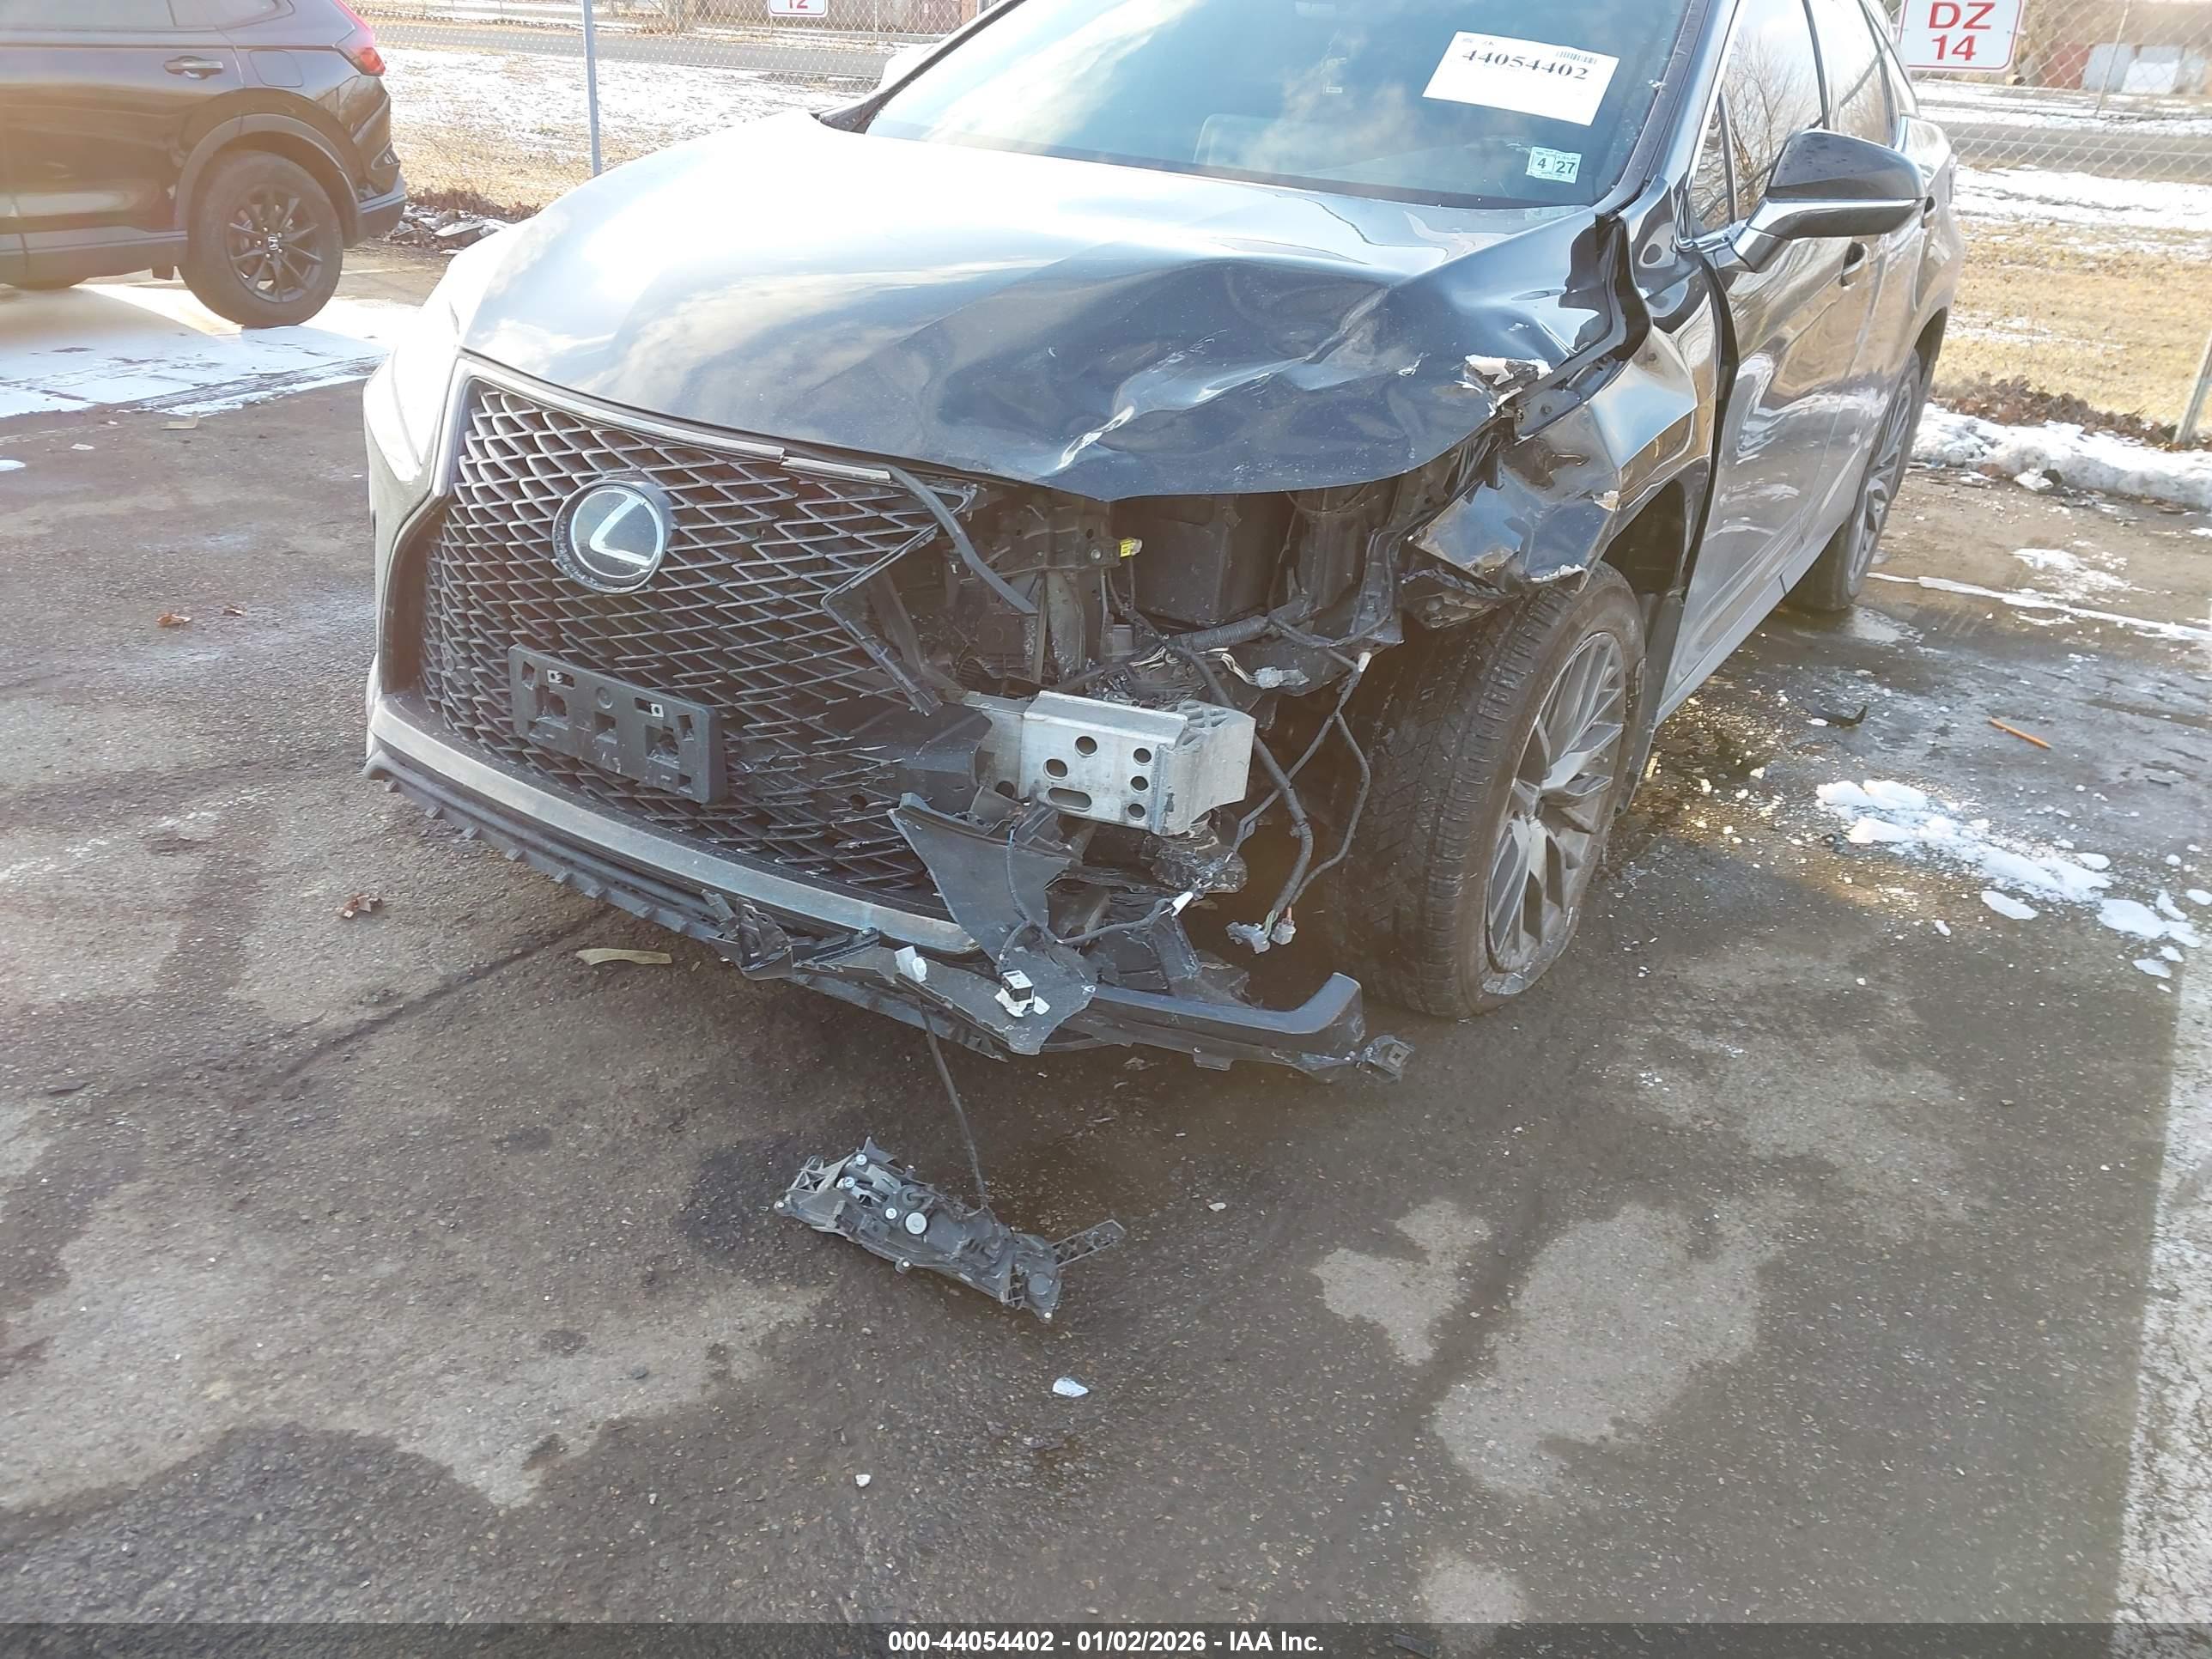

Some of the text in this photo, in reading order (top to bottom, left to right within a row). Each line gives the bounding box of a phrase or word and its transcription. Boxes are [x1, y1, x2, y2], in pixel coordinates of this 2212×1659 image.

[1929, 2, 1996, 30] DZ
[1931, 34, 1977, 61] 14
[1462, 49, 1589, 80] 44054402
[1537, 157, 1547, 169] 4
[1555, 160, 1576, 174] 27
